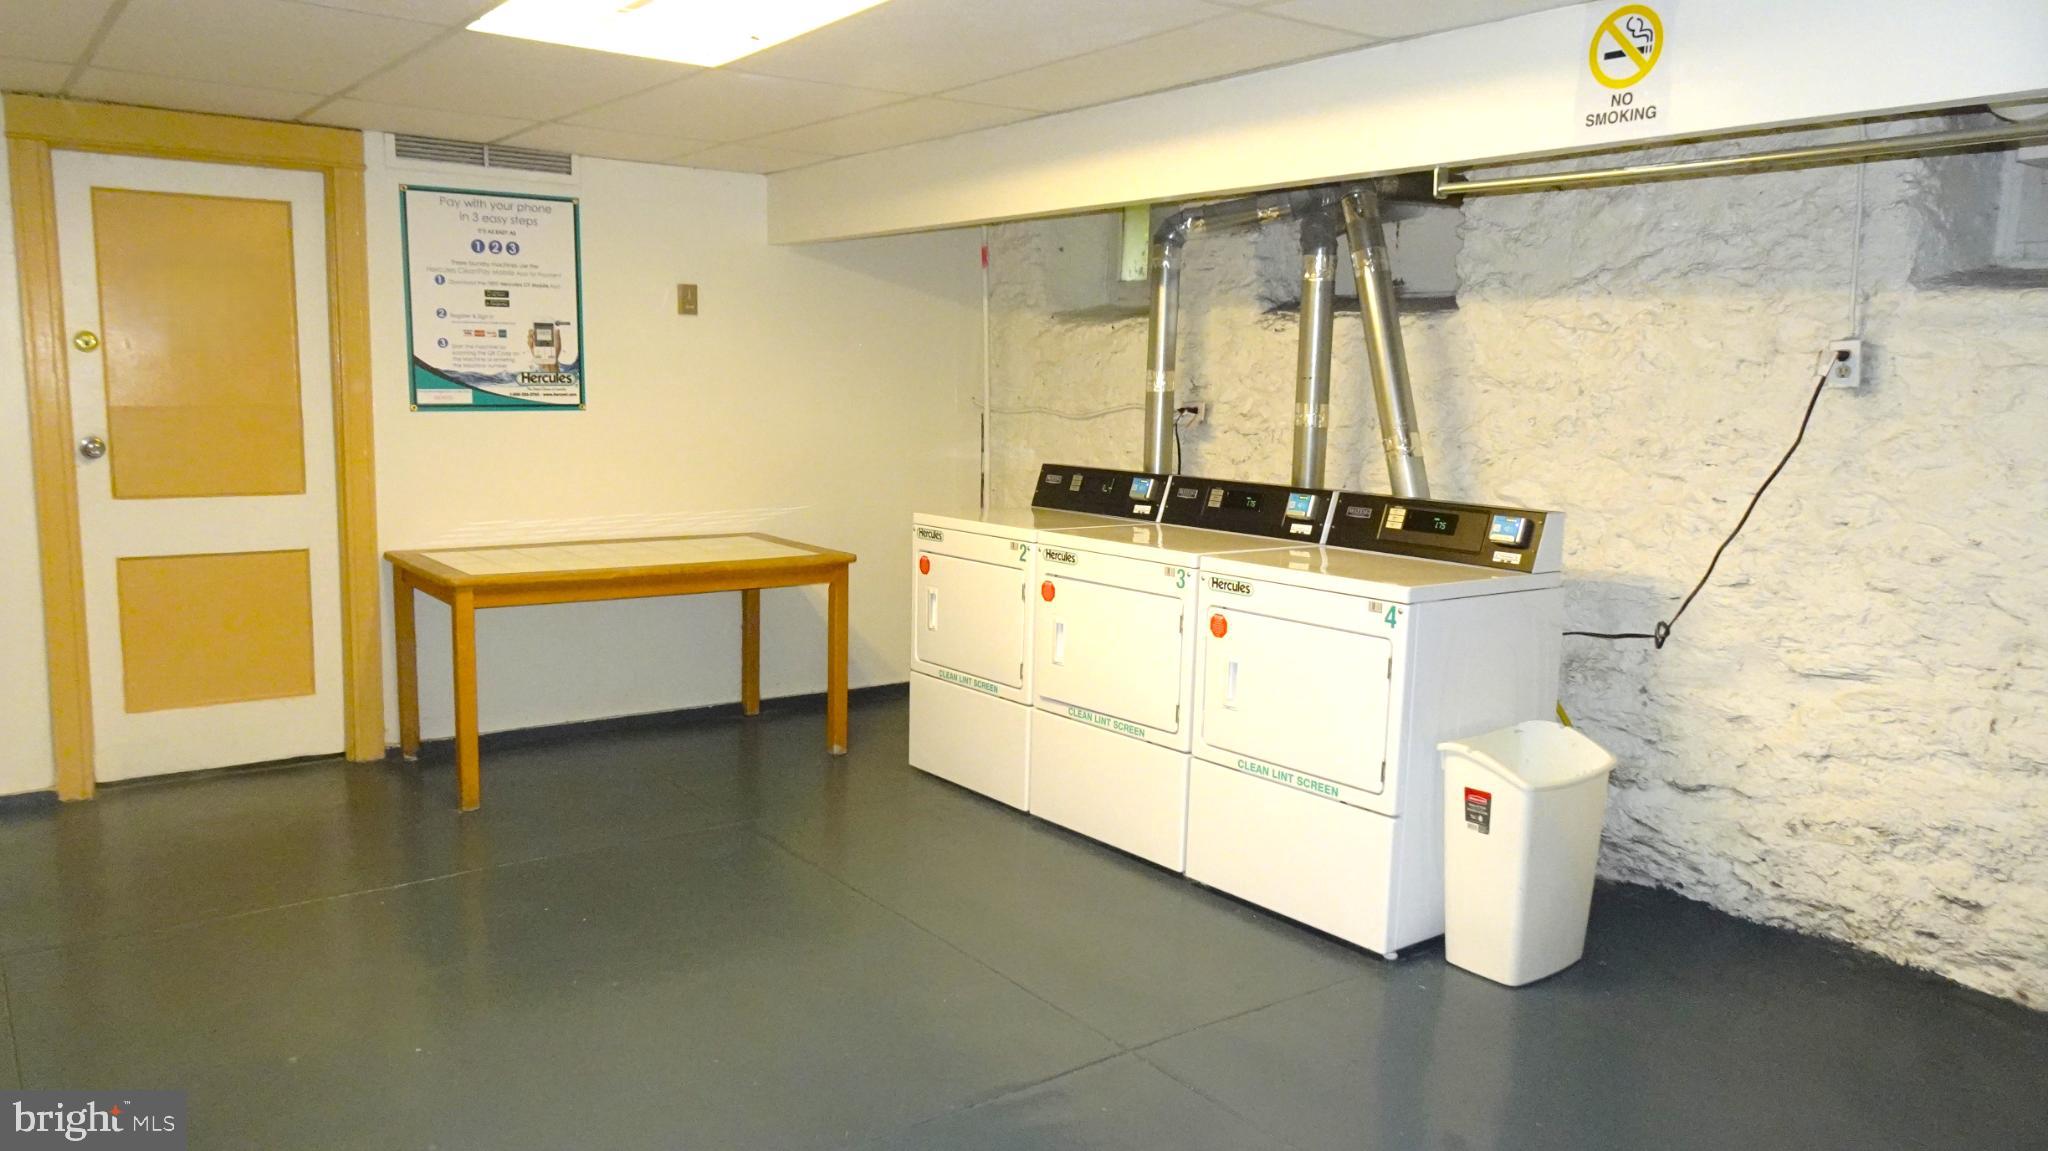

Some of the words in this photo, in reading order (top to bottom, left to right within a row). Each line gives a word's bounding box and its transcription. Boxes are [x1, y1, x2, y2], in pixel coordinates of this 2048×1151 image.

[1611, 92, 1633, 107] NO
[1585, 106, 1657, 127] SMOKING
[439, 196, 461, 209] Pay
[464, 198, 487, 208] with
[490, 201, 513, 211] your
[517, 202, 552, 214] phone
[472, 212, 479, 222] 3
[482, 214, 507, 225] easy
[510, 215, 538, 228] steps
[521, 372, 572, 384] Hercules
[918, 528, 942, 541] Hercules
[1019, 544, 1027, 562] 2
[1045, 549, 1075, 563] Hercules
[1176, 569, 1185, 588] 3
[1211, 577, 1251, 594] Hercules
[1384, 606, 1397, 629] 4
[938, 670, 958, 681] CLEAN
[959, 674, 972, 685] LINT
[973, 679, 999, 694] SCREEN
[1068, 707, 1092, 721] CLEAN
[1094, 715, 1111, 726] LINT
[1113, 720, 1145, 737] SCREEN
[1237, 759, 1270, 776] CLEAN
[1272, 768, 1294, 783] LINT
[1296, 776, 1339, 797] SCREEN
